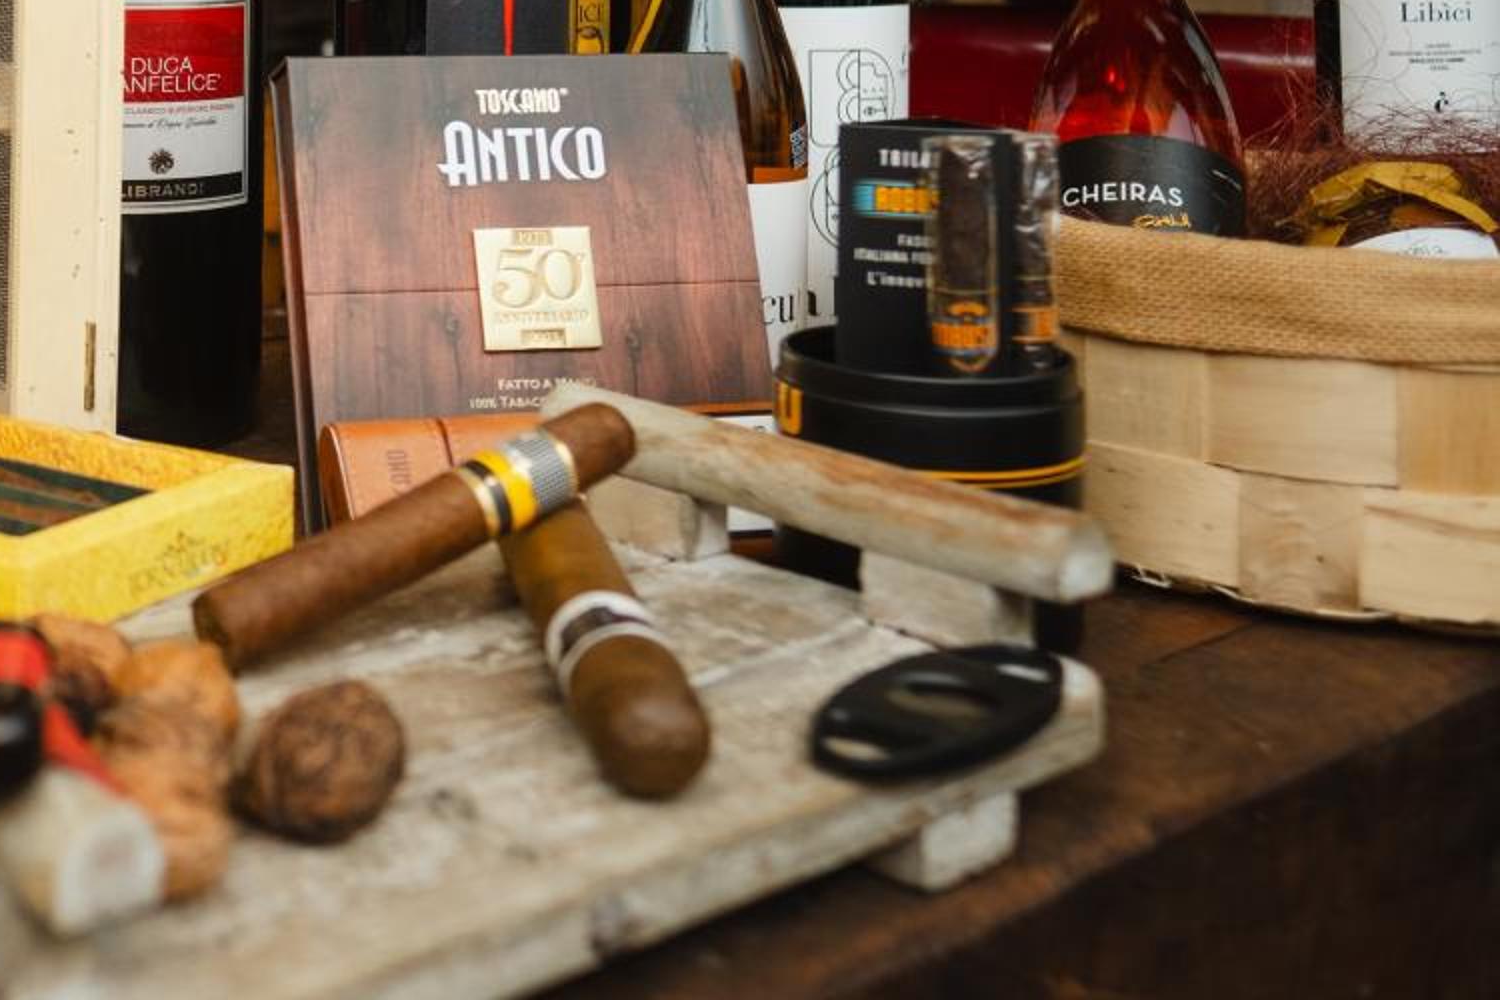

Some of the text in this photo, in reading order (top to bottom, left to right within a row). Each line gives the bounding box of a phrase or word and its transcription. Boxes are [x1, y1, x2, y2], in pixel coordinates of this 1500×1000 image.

[131, 56, 194, 75] DUCA
[436, 120, 607, 187] ANTICO
[1062, 182, 1184, 207] CHEIRAS
[497, 378, 541, 391] FATTO
[543, 378, 553, 390] A
